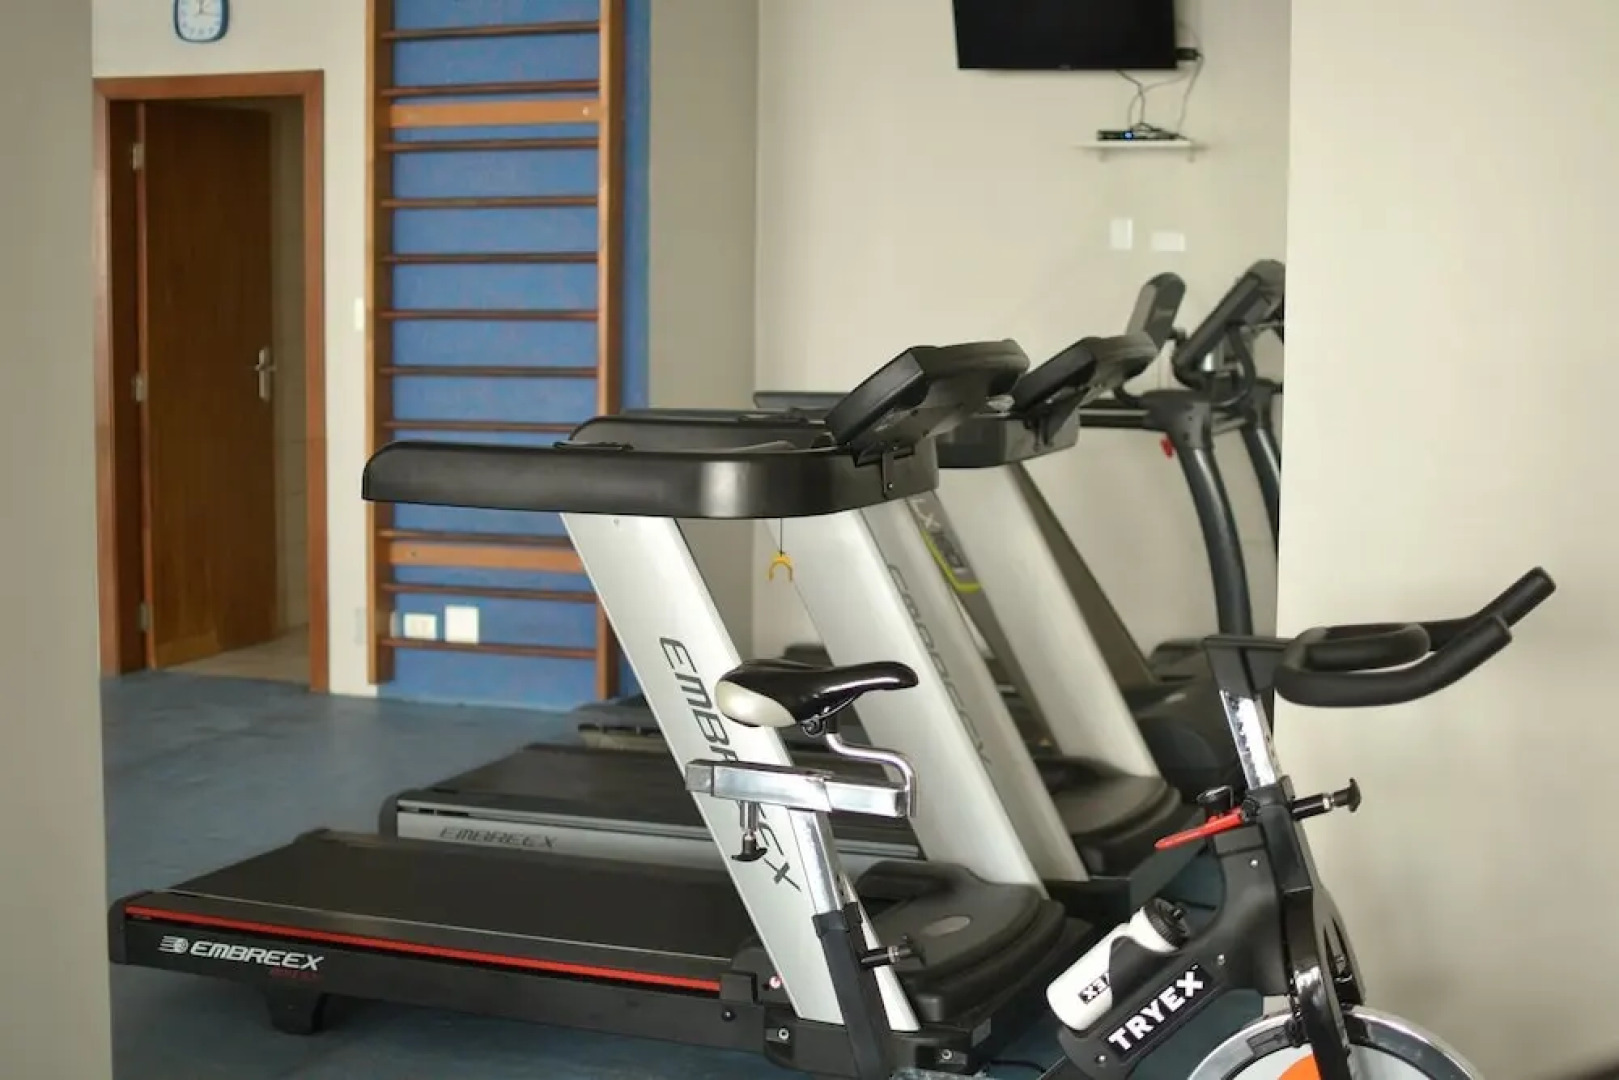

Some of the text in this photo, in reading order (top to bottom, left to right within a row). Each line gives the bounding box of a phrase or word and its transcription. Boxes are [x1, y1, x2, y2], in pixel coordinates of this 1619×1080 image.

[659, 636, 802, 892] EMBEX
[190, 940, 324, 971] EMBREEX
[1108, 970, 1204, 1051] TRYEX
